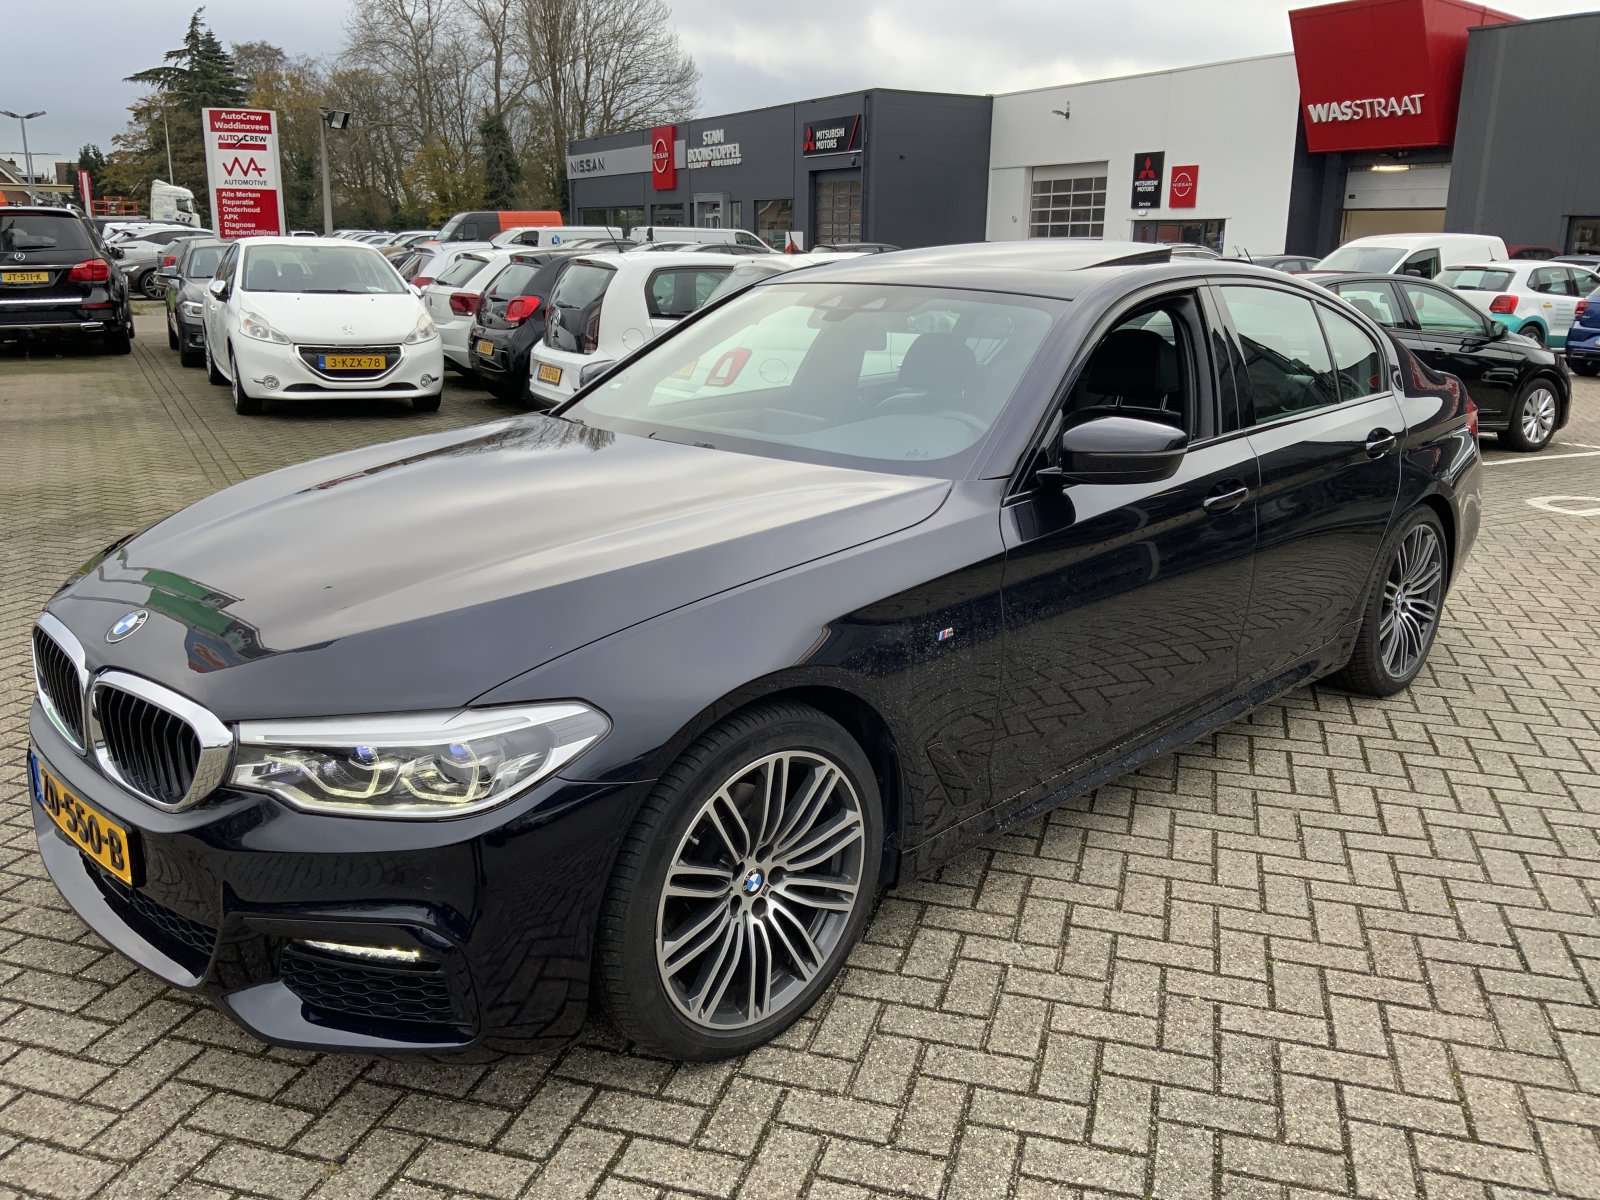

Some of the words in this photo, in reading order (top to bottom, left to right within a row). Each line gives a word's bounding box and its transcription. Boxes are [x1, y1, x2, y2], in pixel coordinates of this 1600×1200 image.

[1308, 93, 1425, 123] WASSTRAAT
[221, 112, 262, 121] AutoCrew
[214, 121, 269, 131] Waddinxveen
[702, 129, 725, 145] STAM
[816, 127, 845, 139] MITSUBISHI
[816, 138, 837, 150] MOTORS
[570, 157, 605, 174] NISSAN
[224, 179, 268, 187] AUTOMOTIVE
[224, 221, 256, 229] Diagnose
[7, 273, 42, 281] JT-511-K
[330, 357, 381, 368] 3-KZX-78
